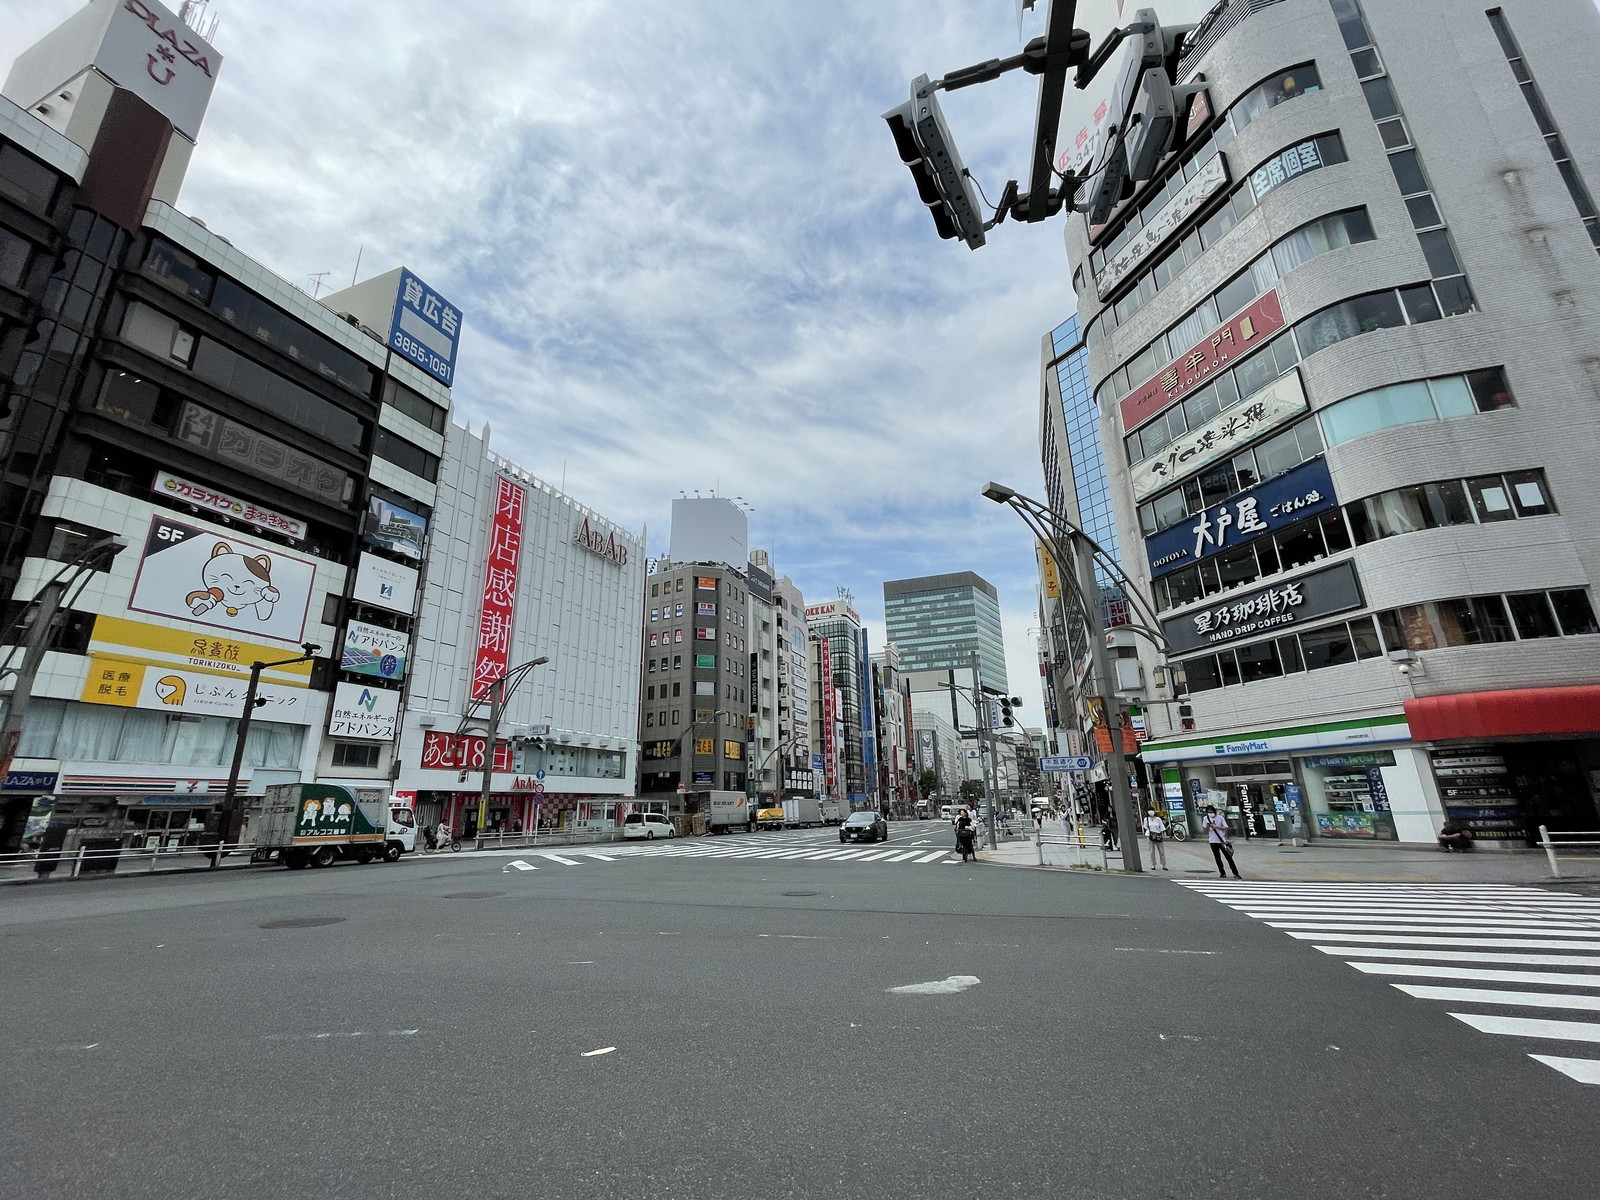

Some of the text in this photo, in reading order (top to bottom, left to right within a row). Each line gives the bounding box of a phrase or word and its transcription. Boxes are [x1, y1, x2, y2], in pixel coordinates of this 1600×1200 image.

[1253, 141, 1320, 199] 全席個室
[402, 277, 457, 336] 貸広告
[394, 331, 451, 380] 3855-1081
[1167, 353, 1229, 398] KIYOUMON
[185, 405, 214, 429] 24
[221, 426, 344, 493] カラオケ
[176, 482, 234, 510] カラオケ
[156, 525, 185, 542] 5F
[1152, 549, 1188, 568] OOTOYA
[474, 478, 526, 697] 閉店感謝祭
[820, 604, 835, 615] KAN
[1193, 582, 1303, 635] 星乃珈琲店
[357, 625, 401, 641] 自然エネルギーの
[1209, 613, 1294, 642] HAND DRIP COFFEE
[190, 639, 240, 661] 鳥貴族
[361, 635, 406, 653] アドバンス
[102, 669, 131, 683] 医療
[188, 657, 237, 672] TORIKIZOKU
[98, 684, 127, 697] 脱毛
[334, 709, 395, 723] 自然エネルギーの
[332, 721, 393, 737] アドバンス
[423, 733, 508, 770] あと18日
[1226, 741, 1268, 753] FamilyMart
[1239, 784, 1258, 837] FamilyMart
